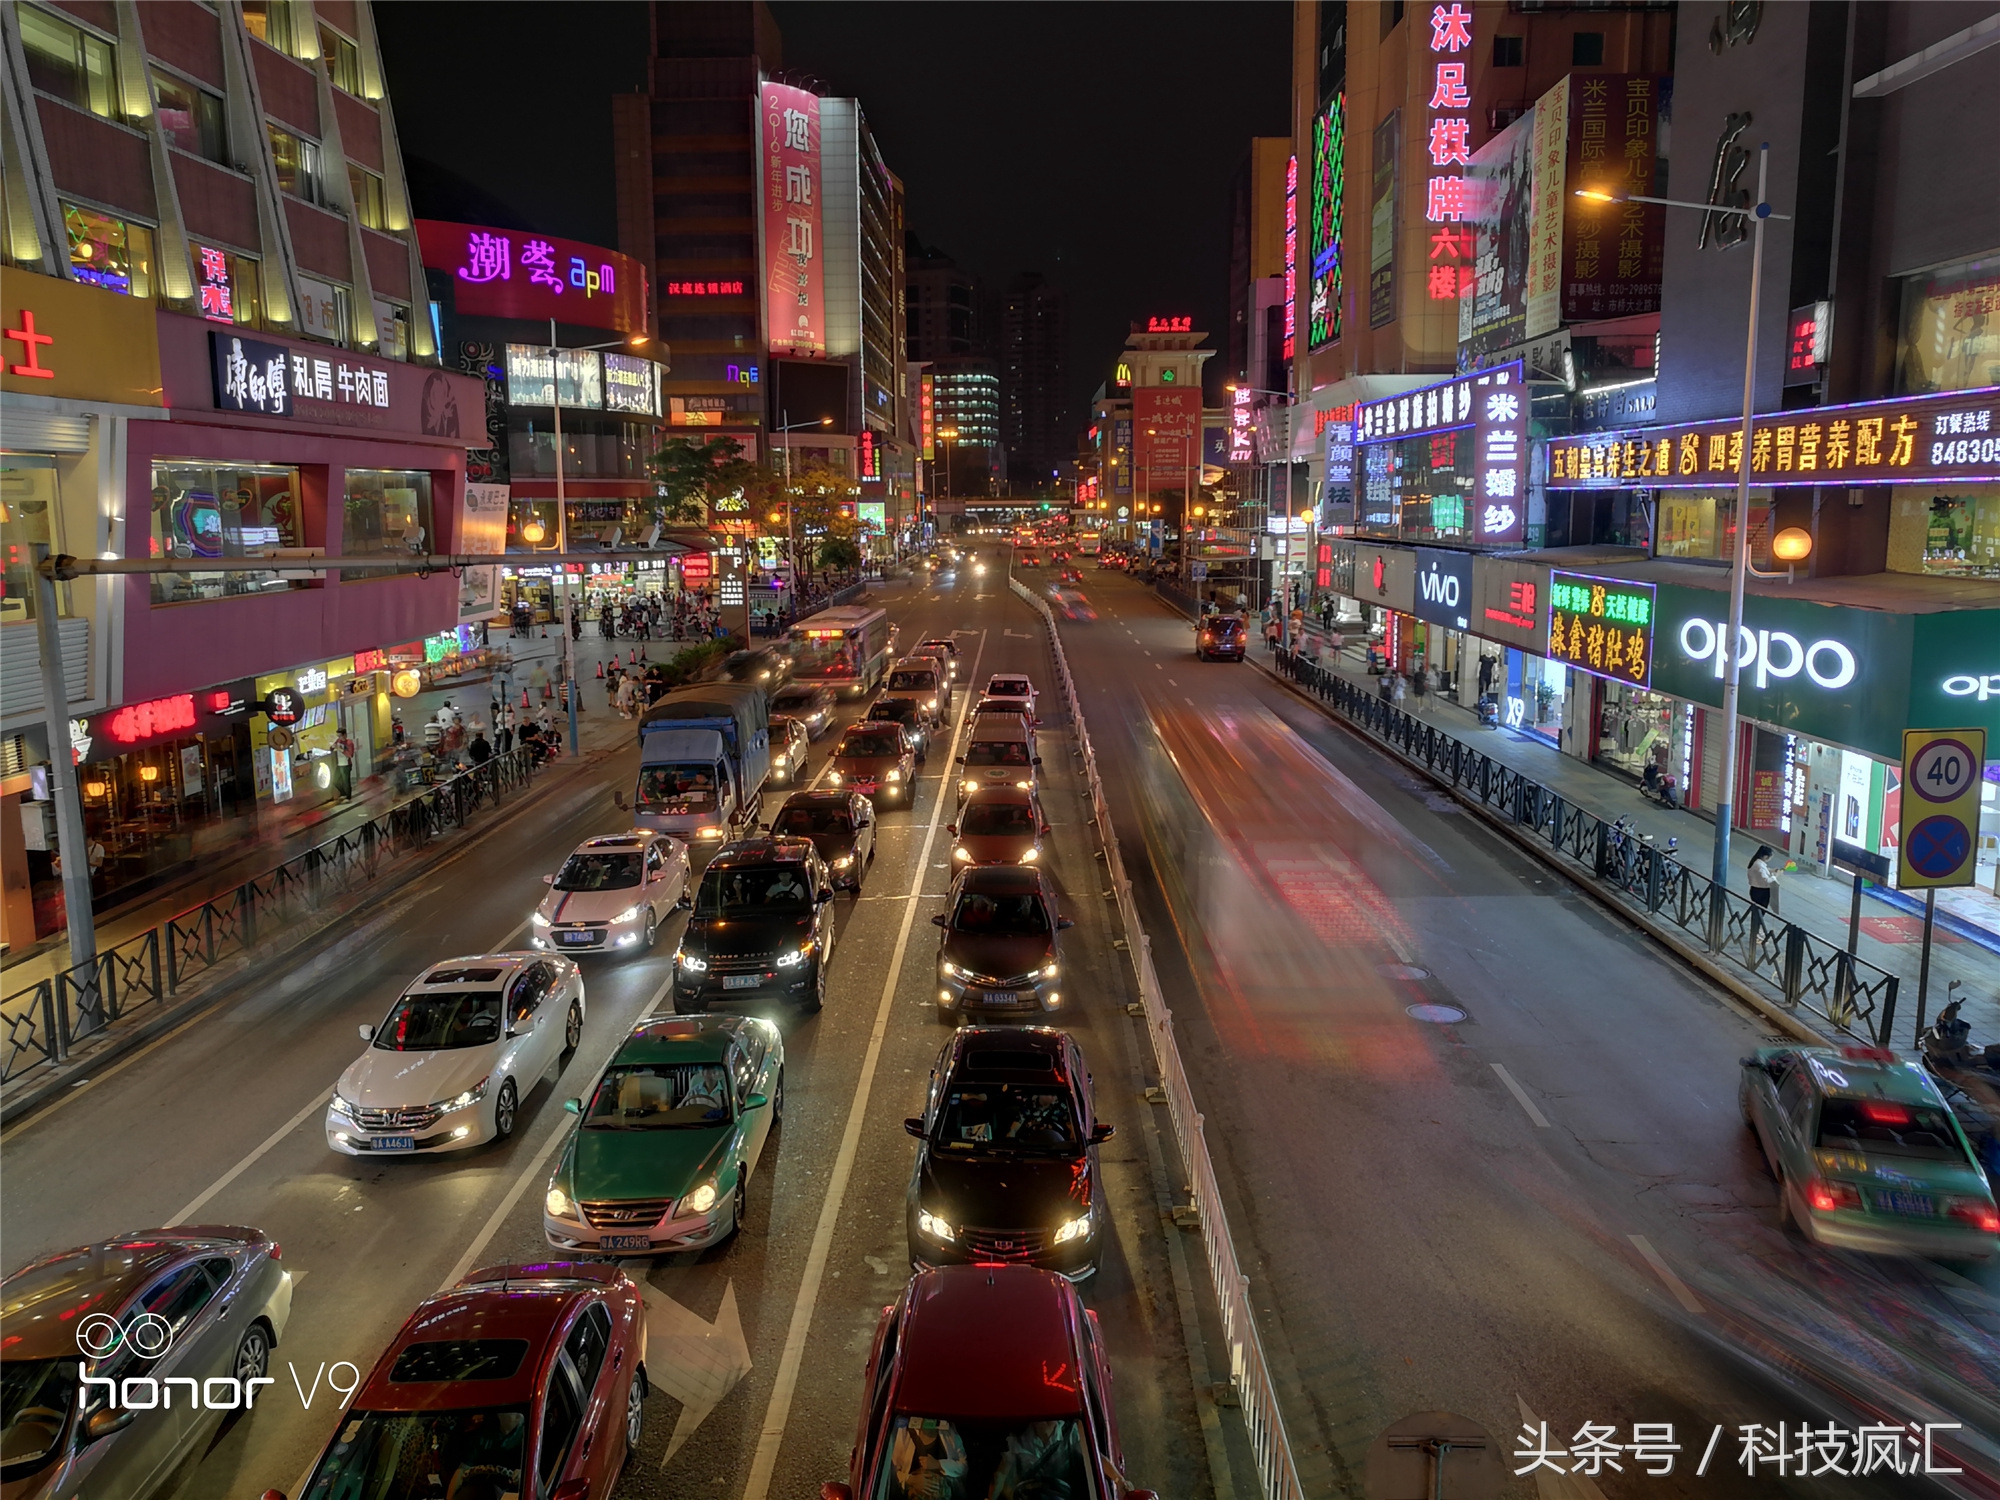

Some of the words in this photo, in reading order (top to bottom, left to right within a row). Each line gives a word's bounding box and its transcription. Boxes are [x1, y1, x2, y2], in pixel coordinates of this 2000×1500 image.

[1426, 3, 1472, 223] 沐足棋牌
[769, 96, 783, 212] 2016新年进步
[783, 107, 812, 259] 您成功
[1575, 79, 1607, 278] 米兰国际高纱摄影
[1617, 78, 1650, 278] 宝贝印象儿童艺术摄影
[1542, 84, 1564, 293] 宝贝印象儿童艺术摄影
[458, 232, 564, 296] 潮荟
[570, 257, 614, 298] apm
[668, 282, 743, 295] 汉庭连锁酒店
[1428, 228, 1461, 300] 六楼
[0, 309, 55, 379] 士
[226, 337, 288, 414] 康師傅
[1230, 450, 1252, 460] KTV
[1329, 424, 1353, 482] 清颜堂
[1553, 438, 1671, 479] 五朝皇宫养生之道
[1708, 414, 1919, 475] 四季养胃营养配方
[1935, 410, 1991, 436] 订餐热线
[1483, 393, 1519, 534] 米兰婚纱
[1420, 561, 1460, 607] vivo
[1605, 594, 1650, 624] 天然健康
[1680, 617, 1856, 689] oppo
[1506, 696, 1525, 728] X9
[1927, 756, 1961, 786] 40
[662, 806, 689, 815] JAC
